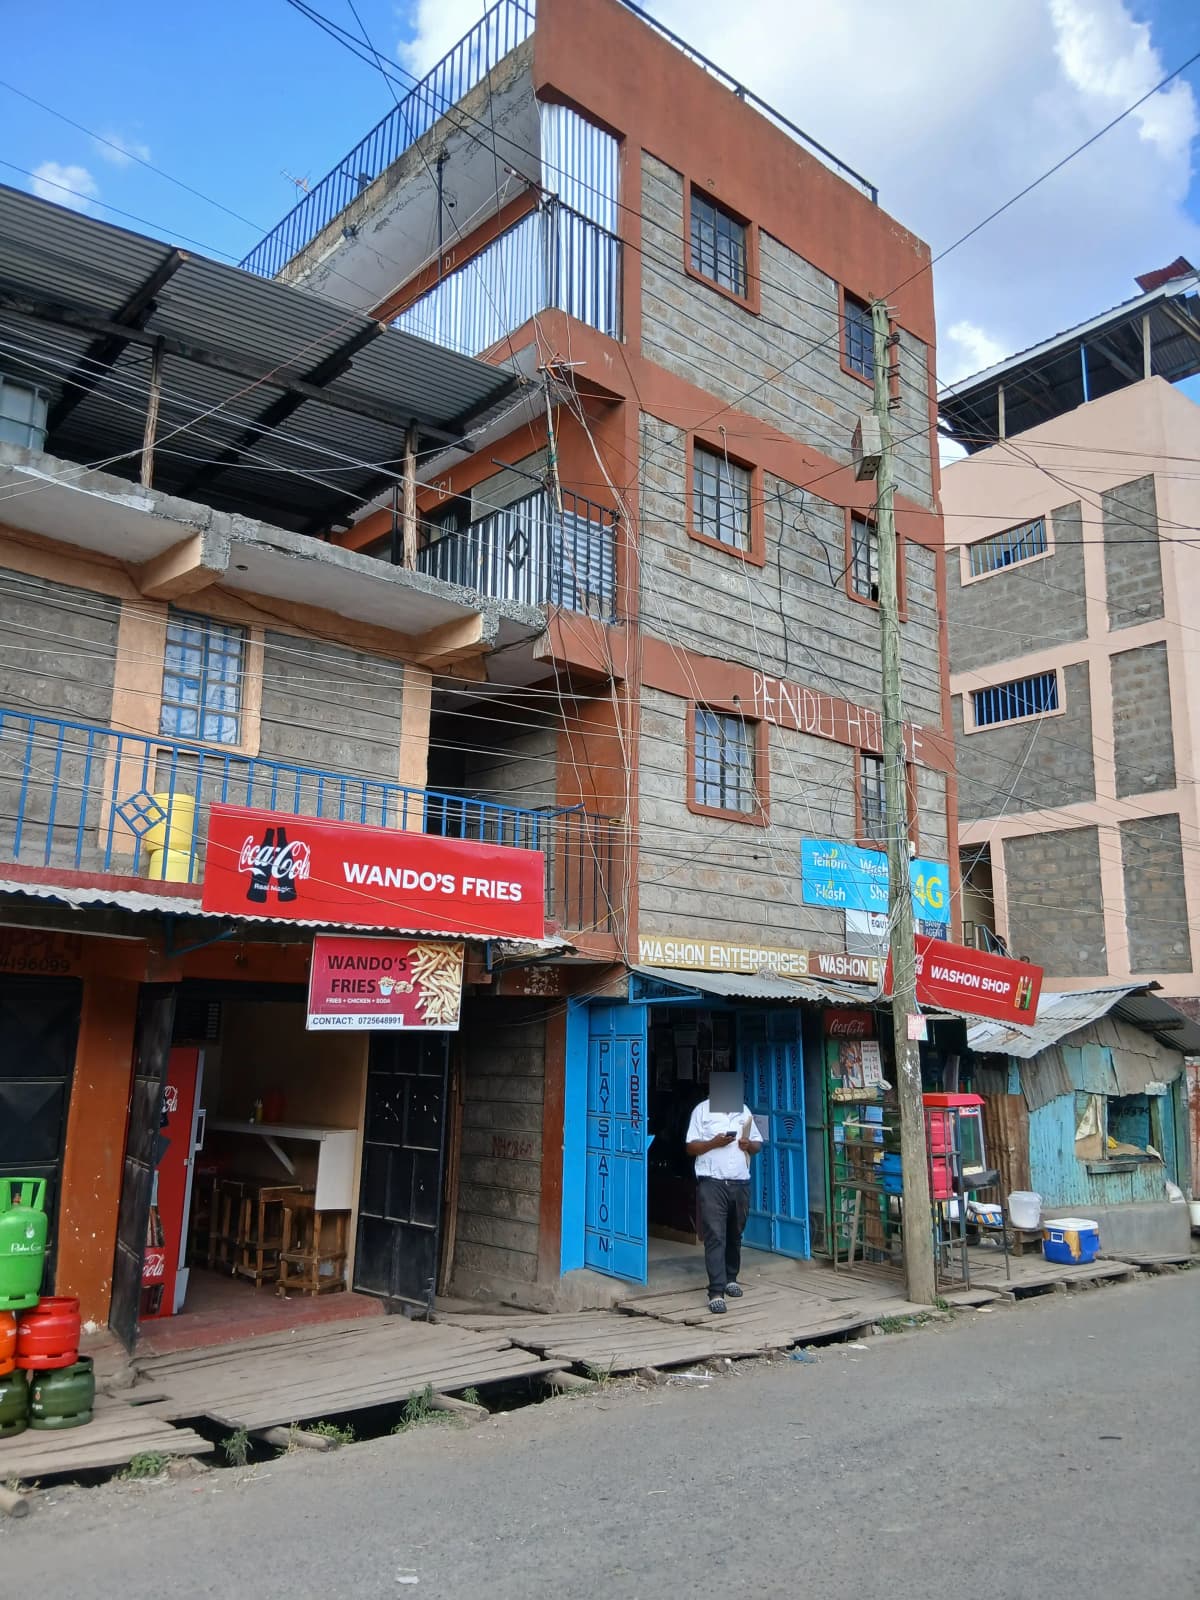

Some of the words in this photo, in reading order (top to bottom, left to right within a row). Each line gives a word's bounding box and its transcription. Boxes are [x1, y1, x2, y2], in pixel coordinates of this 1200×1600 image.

[753, 672, 835, 738] PENDU
[238, 836, 311, 880] Coca-Cola
[343, 861, 456, 894] WANDO'S
[462, 876, 522, 902] FRIES
[913, 874, 944, 909] 4G
[327, 955, 408, 972] WANDO'S
[638, 940, 705, 966] WASHON
[710, 946, 808, 974] ENTERPRISES
[818, 954, 869, 978] WASHON
[331, 978, 377, 994] FRIES
[930, 964, 981, 988] WASHON
[981, 976, 1011, 995] SHOP
[312, 1017, 354, 1025] CONTACT:
[630, 1041, 641, 1129] CYBER
